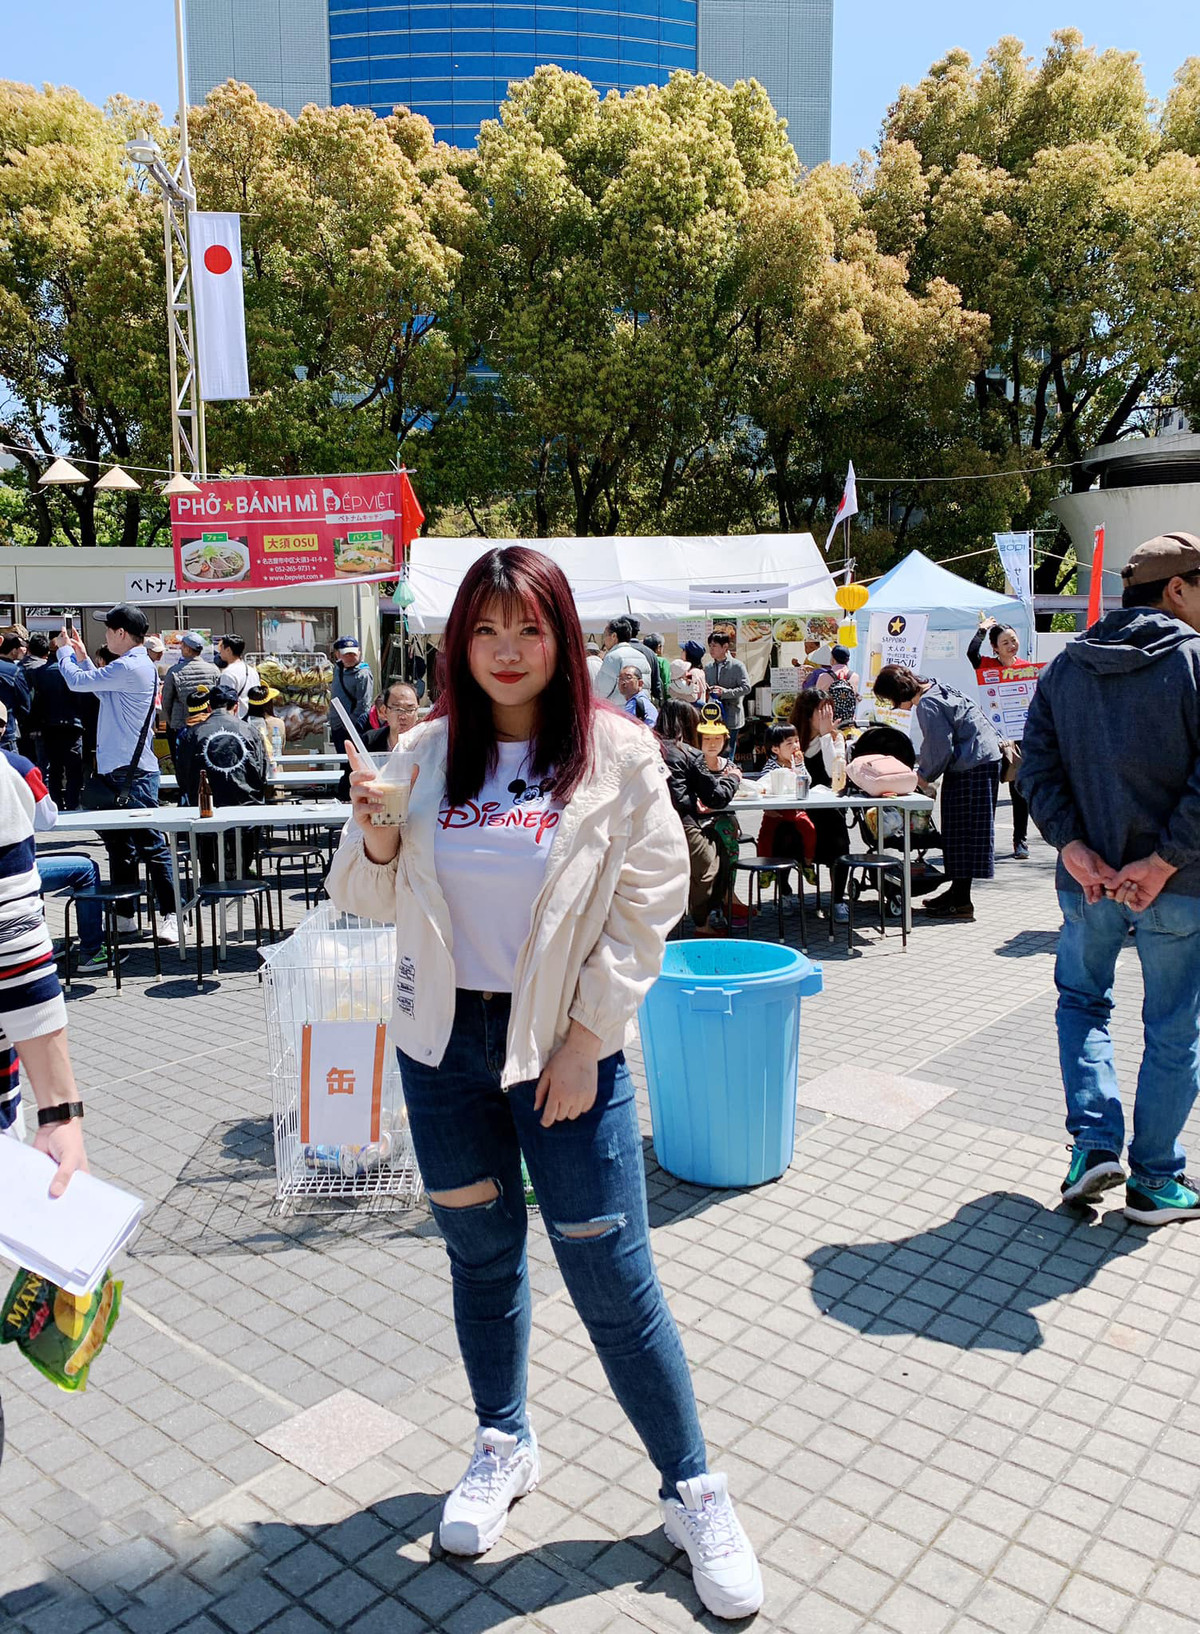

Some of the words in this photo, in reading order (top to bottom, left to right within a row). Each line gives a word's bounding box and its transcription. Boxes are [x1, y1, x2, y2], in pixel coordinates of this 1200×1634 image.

[177, 493, 221, 515] PHỞ
[236, 491, 292, 514] BÁNH
[295, 489, 318, 512] MÌ
[338, 513, 384, 522] ベトナムキッチン
[267, 538, 291, 549] 大須
[293, 537, 315, 548] OSU
[268, 573, 319, 581] www.bepviet.com
[882, 636, 907, 644] SAPPORO
[326, 1067, 356, 1095] 缶
